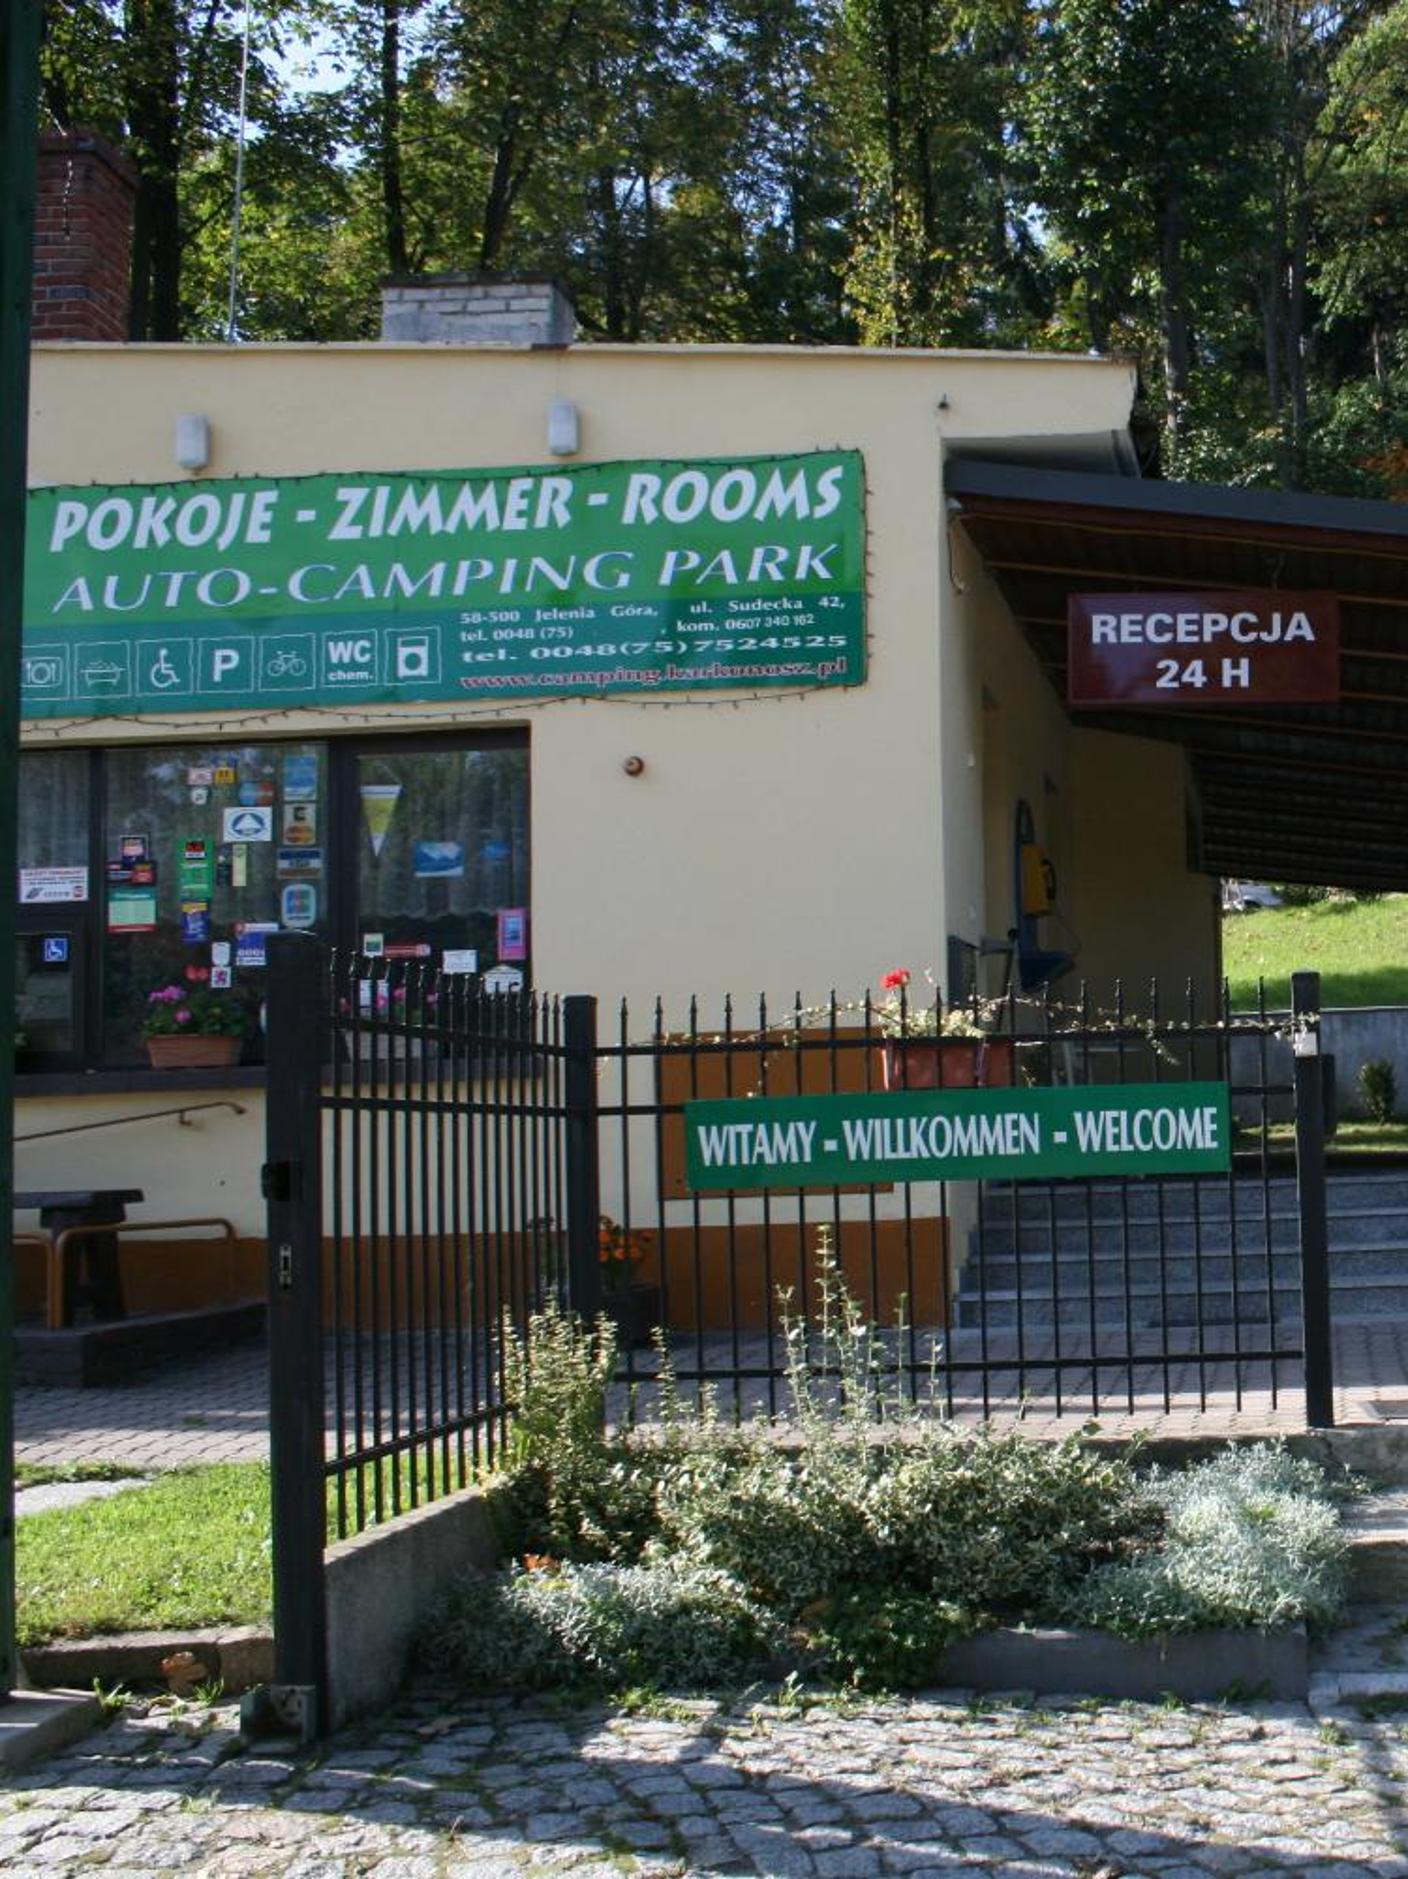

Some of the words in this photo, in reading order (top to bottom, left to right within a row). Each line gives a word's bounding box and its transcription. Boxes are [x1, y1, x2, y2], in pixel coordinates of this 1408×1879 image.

[50, 490, 279, 552] POKOJE
[328, 477, 574, 540] ZIMMER
[621, 465, 844, 526] ROOMS
[658, 543, 839, 587] PARK
[459, 610, 520, 625] 58-500
[535, 606, 596, 622] Jelenia
[610, 604, 658, 618] Góra,
[690, 601, 713, 614] ul.
[728, 597, 804, 613] Sudecka
[818, 596, 845, 609] 42,
[677, 619, 719, 633] kom.
[725, 617, 760, 631] 0607
[764, 615, 790, 628] 340
[460, 629, 488, 642] tel.
[493, 627, 534, 641] 0048
[540, 626, 574, 640] (75)
[1091, 611, 1316, 644] RECEPCJA
[213, 649, 240, 683] P
[328, 640, 371, 663] WC
[463, 648, 517, 663] tel.
[327, 670, 373, 681] chem.
[1156, 658, 1207, 688] 24
[1221, 657, 1250, 688] H
[697, 1121, 816, 1166] WITAMY
[841, 1112, 1040, 1161] WILLKOMMEN
[1073, 1106, 1219, 1153] WELCOME
